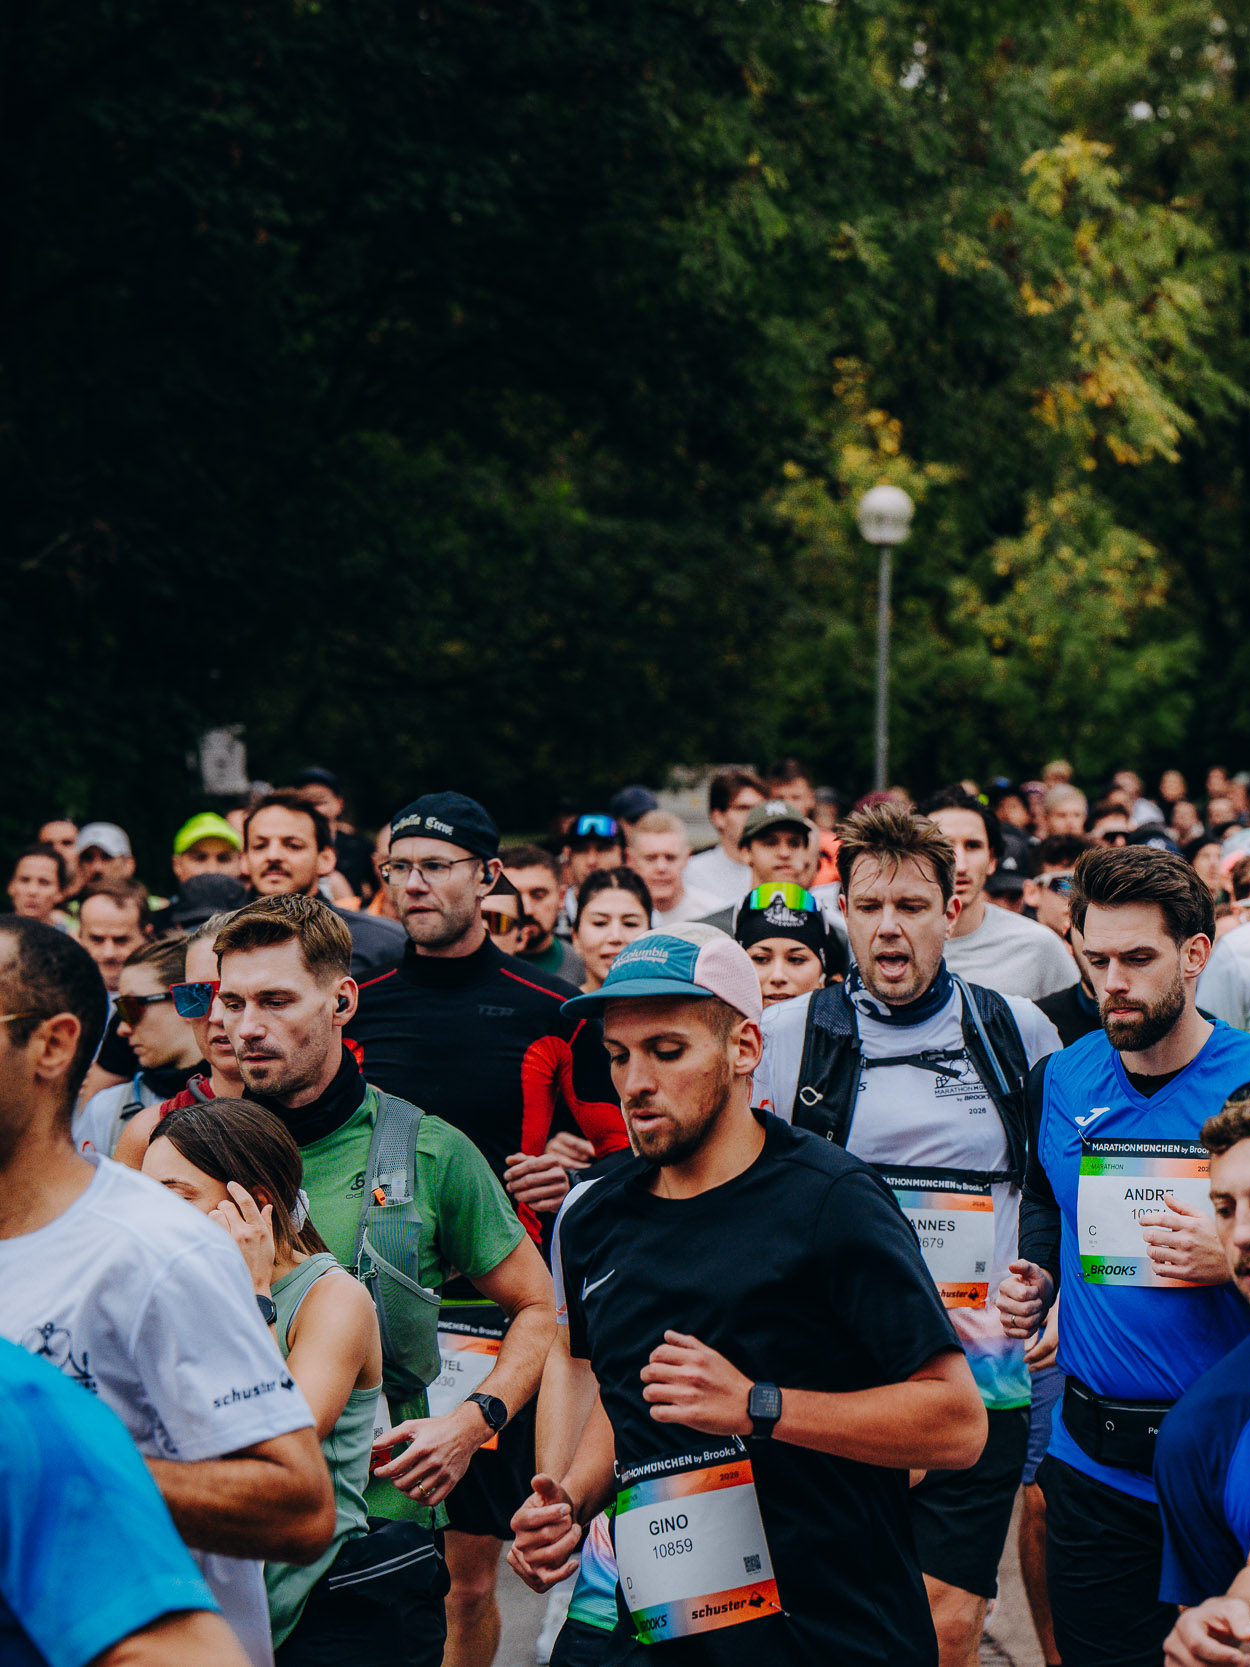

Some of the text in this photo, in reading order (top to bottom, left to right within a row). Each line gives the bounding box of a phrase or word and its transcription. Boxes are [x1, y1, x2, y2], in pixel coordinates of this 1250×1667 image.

[620, 946, 668, 961] Columbia
[1181, 1146, 1188, 1154] by
[962, 1182, 983, 1192] Brooks
[1088, 1224, 1097, 1236] C
[1090, 1264, 1137, 1276] BROOKS
[939, 1289, 969, 1298] huster
[1148, 1426, 1159, 1435] Pe
[693, 1455, 702, 1463] by
[703, 1447, 737, 1461] Brooks
[649, 1514, 689, 1536] GINO
[653, 1538, 693, 1559] 10859
[691, 1598, 747, 1620] schuster
